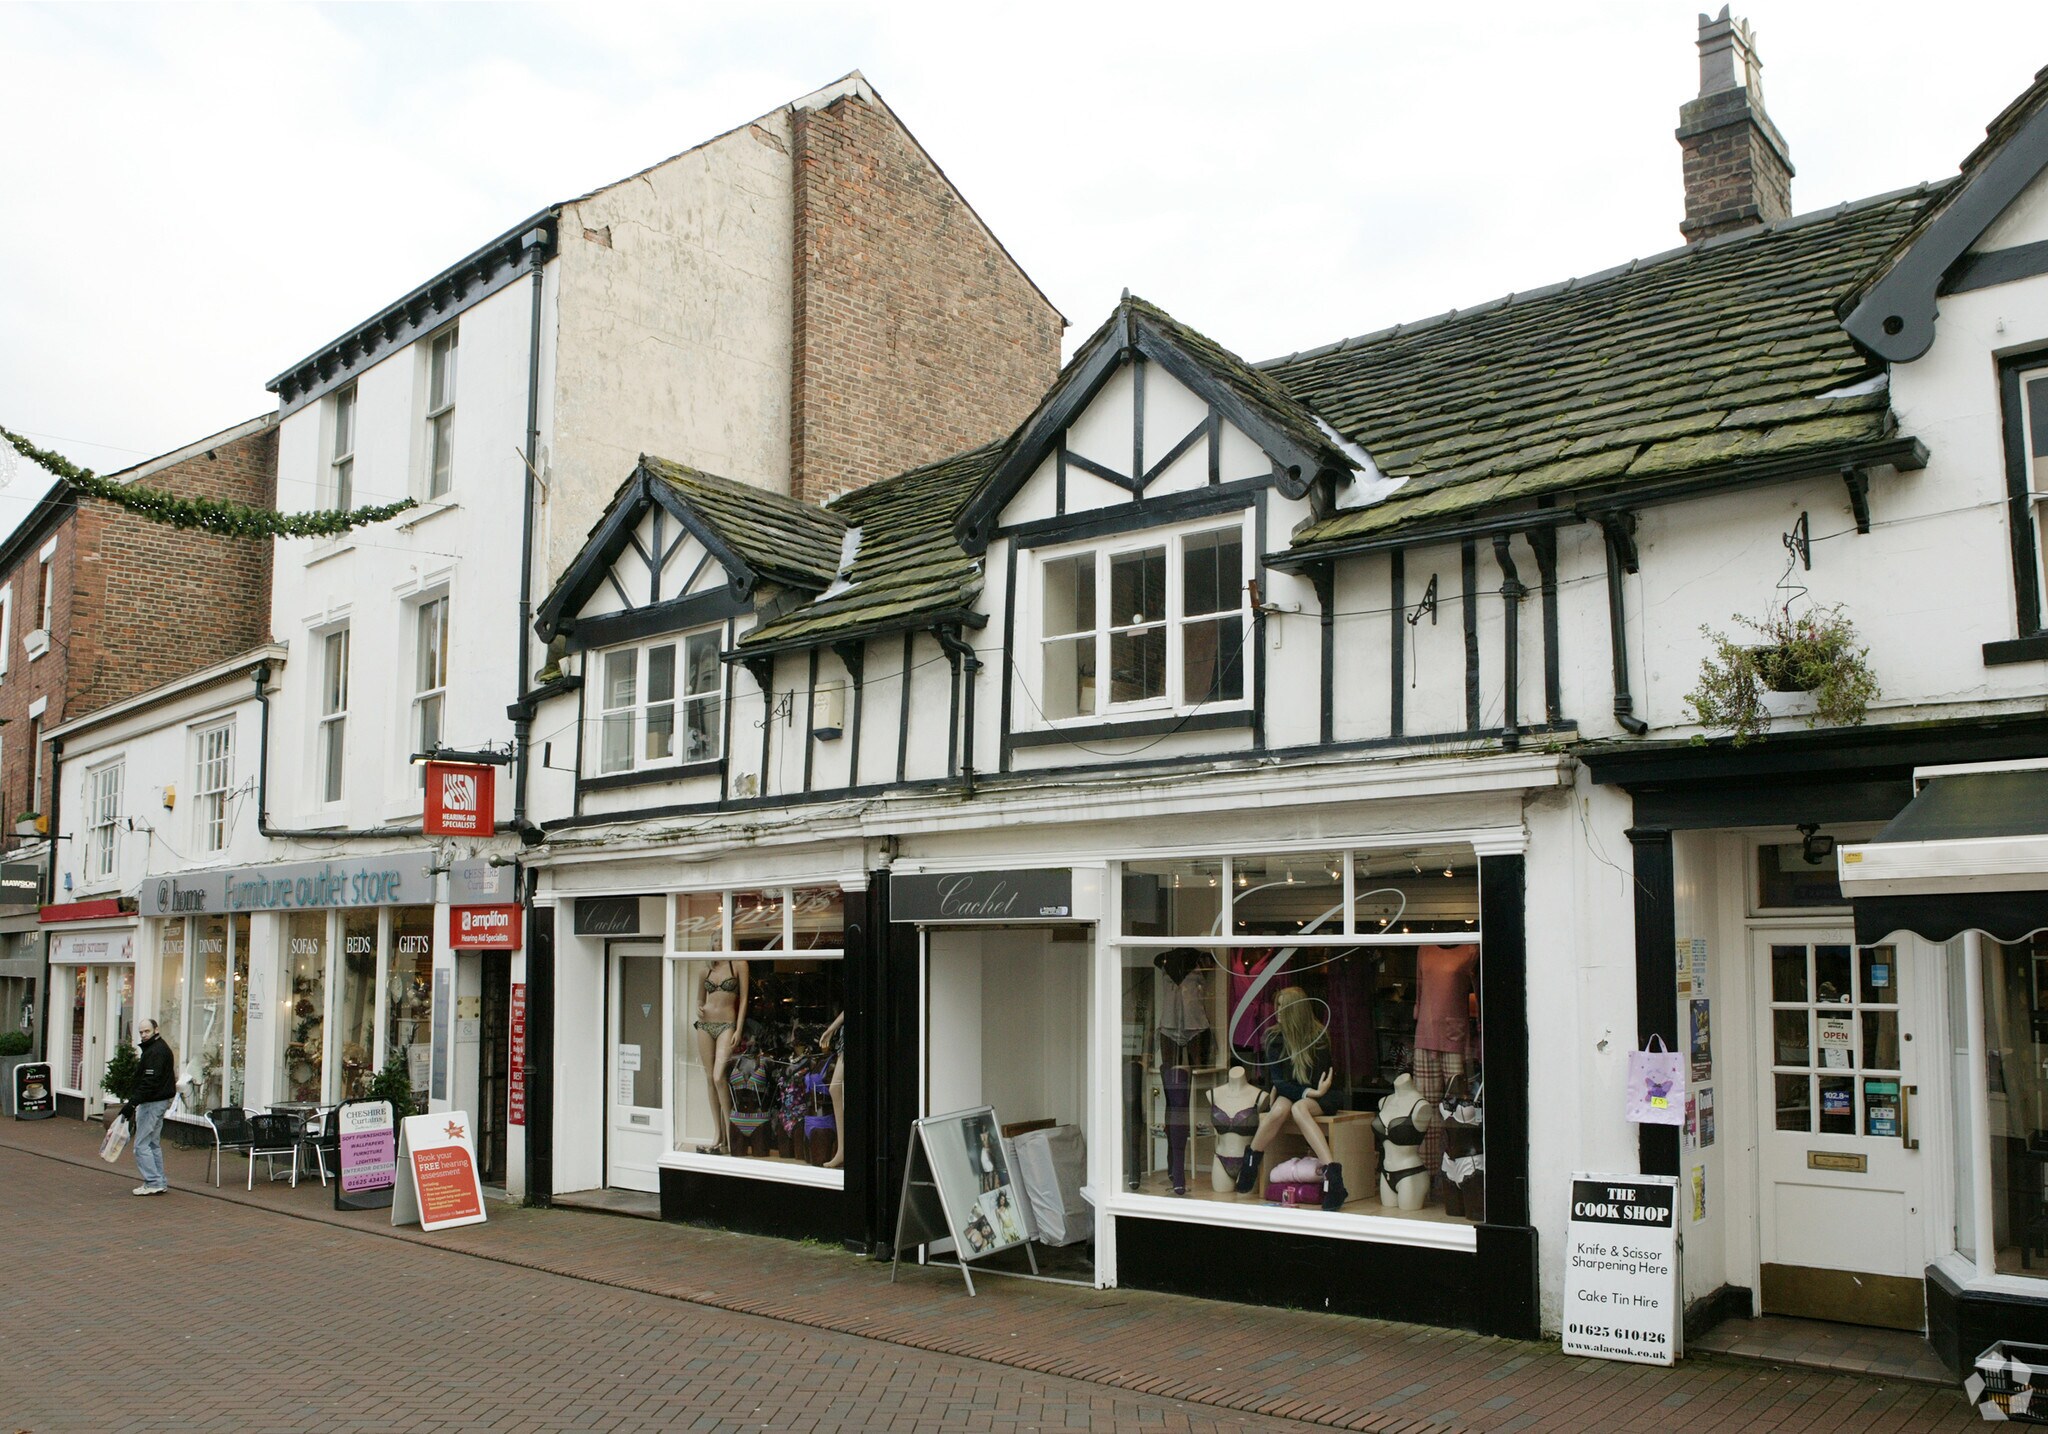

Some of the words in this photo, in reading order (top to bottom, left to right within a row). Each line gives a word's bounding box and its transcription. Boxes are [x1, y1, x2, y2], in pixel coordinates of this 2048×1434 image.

[442, 813, 466, 821] HEARING
[467, 814, 476, 822] AID
[442, 821, 476, 829] SPECIALISTS
[1, 879, 37, 889] MAWSON
[224, 872, 292, 909] Furniture
[295, 864, 348, 906] outlet
[351, 868, 401, 902] store
[172, 879, 206, 912] home
[937, 874, 1019, 916] Cachet
[472, 910, 509, 930] amplifon
[582, 898, 632, 933] Cachet
[346, 936, 371, 954] BEDS
[398, 935, 429, 954] GIFTS
[461, 933, 478, 944] Hearing
[486, 933, 509, 943] Specialists
[199, 938, 223, 954] DINING
[291, 938, 318, 954] SOFAS
[1823, 1031, 1848, 1040] OPEN
[346, 1107, 387, 1119] CHESHIRE
[351, 1117, 383, 1126] Curtains
[356, 1131, 392, 1140] FURNISHINGS
[351, 1140, 385, 1149] WALLPAPERS
[353, 1149, 383, 1157] FURNITURE
[417, 1153, 435, 1163] Book
[436, 1152, 452, 1162] your
[355, 1157, 382, 1165] LIGHTING
[419, 1161, 440, 1172] FREE
[440, 1159, 469, 1169] hearing
[343, 1166, 372, 1175] INTERIOR
[373, 1163, 394, 1171] DESIGN
[420, 1168, 461, 1180] assessment
[347, 1179, 367, 1187] 01625
[1607, 1187, 1636, 1202] THE
[1574, 1202, 1620, 1219] COOK
[1623, 1206, 1669, 1222] SHOP
[1577, 1243, 1607, 1256] Knife
[1610, 1245, 1619, 1257] &
[1622, 1246, 1662, 1260] Scissor
[1572, 1256, 1636, 1275] Sharpening
[1639, 1262, 1668, 1275] Here
[1577, 1289, 1607, 1304] Cake
[1612, 1292, 1630, 1305] Tin
[1633, 1295, 1659, 1308] Hire
[1569, 1323, 1610, 1338] 01625
[1614, 1328, 1666, 1344] 610426
[1567, 1342, 1667, 1360] www.alacook.co.uk
